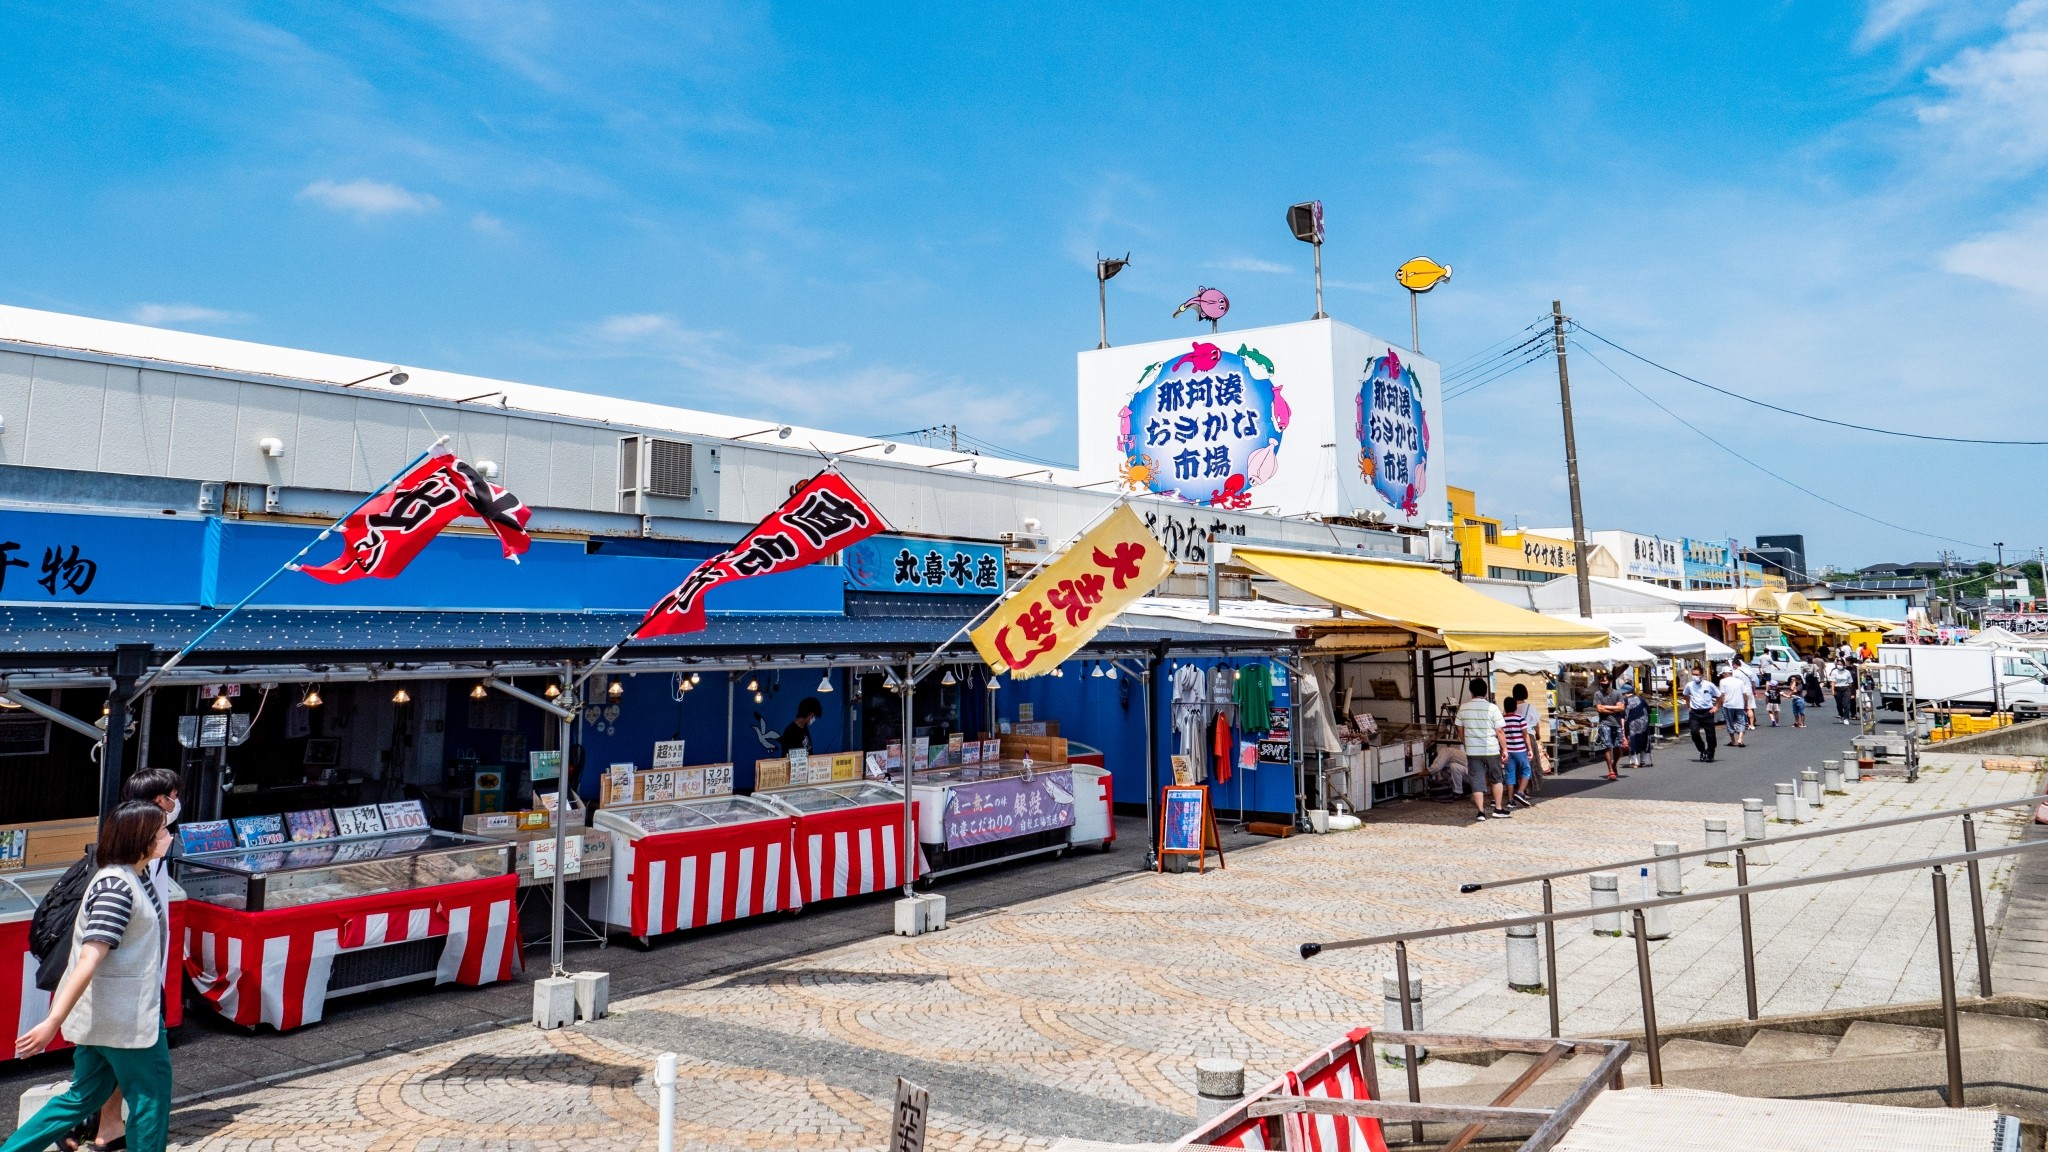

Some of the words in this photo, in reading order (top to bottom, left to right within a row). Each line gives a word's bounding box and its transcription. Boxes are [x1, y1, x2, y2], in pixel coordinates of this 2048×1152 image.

[1157, 372, 1244, 412] 那珂湊
[1373, 378, 1412, 419] 那珂湊
[1146, 408, 1259, 446] おさかな
[1369, 411, 1418, 452] おさかな
[1172, 444, 1232, 480] 市場
[1382, 449, 1409, 485] 市場
[894, 548, 999, 589] 丸喜水産
[994, 541, 1146, 671] 大売出し
[647, 773, 671, 783] マグロ
[708, 768, 730, 777] マグロ
[350, 807, 376, 822] 干物
[949, 792, 1007, 816] 唯一無二の味
[1013, 789, 1043, 818] 銀鮭
[341, 820, 380, 835] 3枚で
[949, 814, 1013, 838] 丸喜こだわりの
